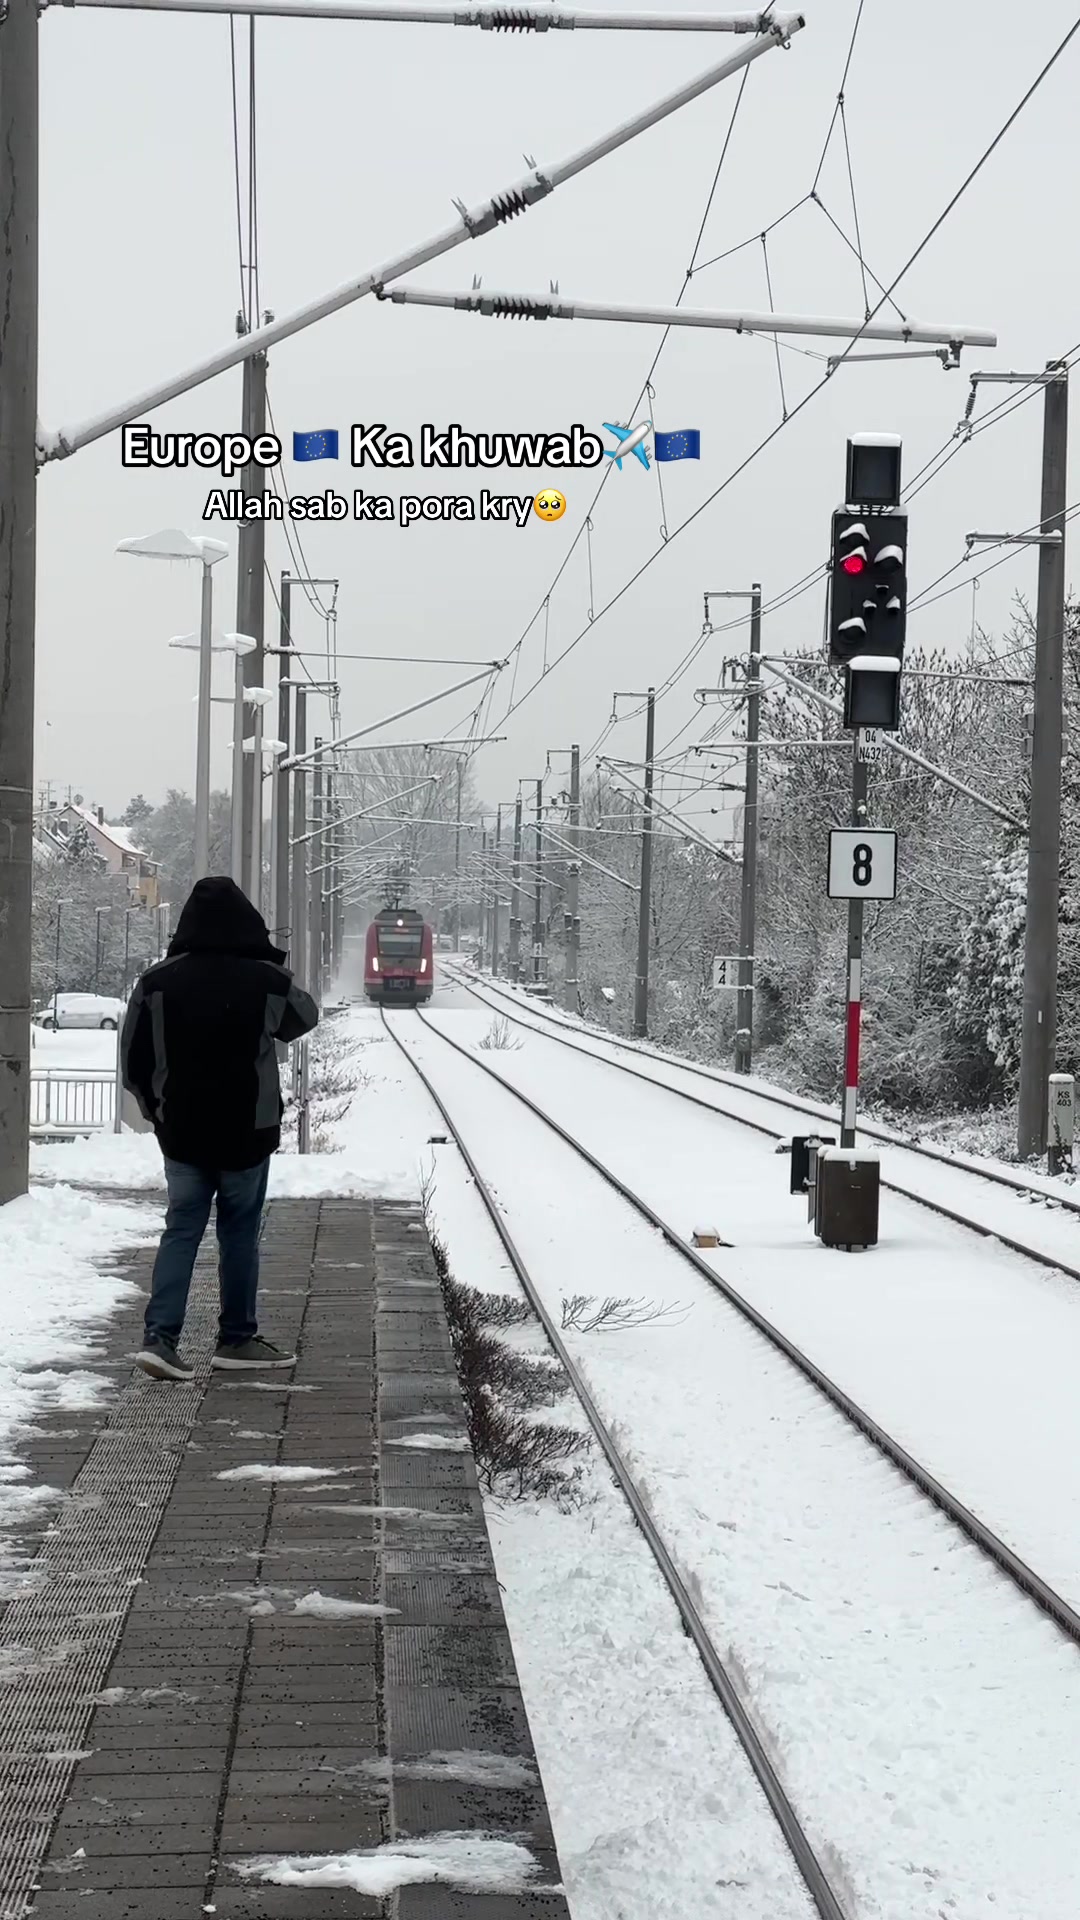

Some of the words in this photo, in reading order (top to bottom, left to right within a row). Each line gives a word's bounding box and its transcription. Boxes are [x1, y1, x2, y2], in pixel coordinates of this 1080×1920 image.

[865, 730, 876, 743] 04
[859, 746, 881, 760] N432
[853, 843, 872, 886] 8
[718, 961, 726, 972] 4
[718, 974, 726, 985] 4
[1058, 1090, 1070, 1098] KS
